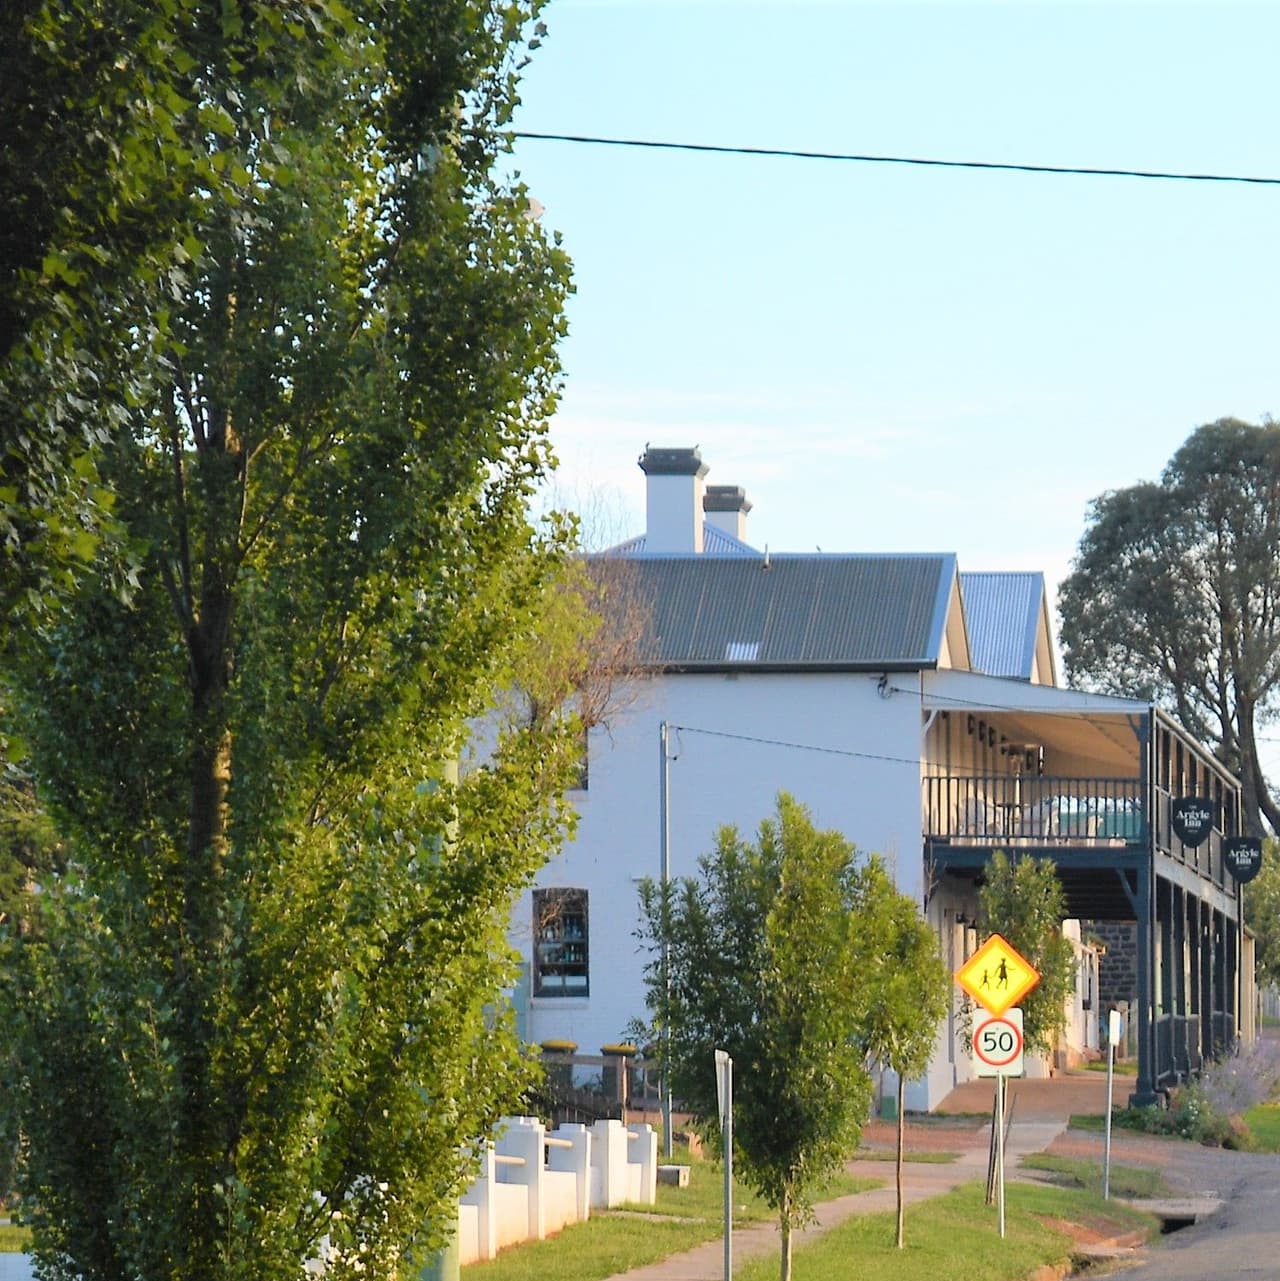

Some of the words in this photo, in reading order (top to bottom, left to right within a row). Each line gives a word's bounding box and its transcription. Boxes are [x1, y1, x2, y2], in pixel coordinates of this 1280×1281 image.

[1176, 809, 1210, 820] Argyle
[1184, 819, 1202, 827] Inn
[1228, 848, 1260, 858] Argyle
[1235, 857, 1252, 865] Inn
[984, 1032, 1013, 1052] 50
